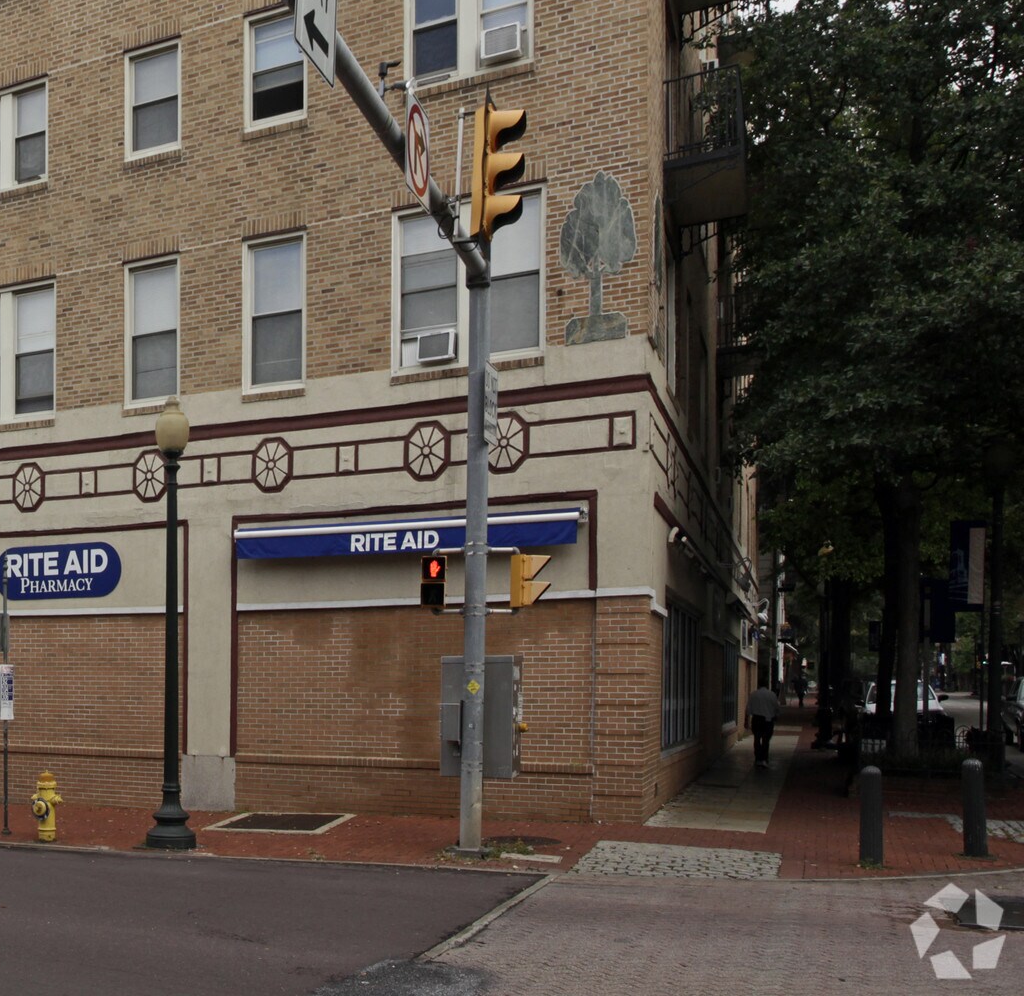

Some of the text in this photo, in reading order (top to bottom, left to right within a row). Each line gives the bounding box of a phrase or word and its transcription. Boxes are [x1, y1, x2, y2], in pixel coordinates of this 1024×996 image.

[350, 530, 440, 552] RITE AID
[6, 548, 108, 578] RITE AID
[20, 577, 93, 594] PHARMACY
